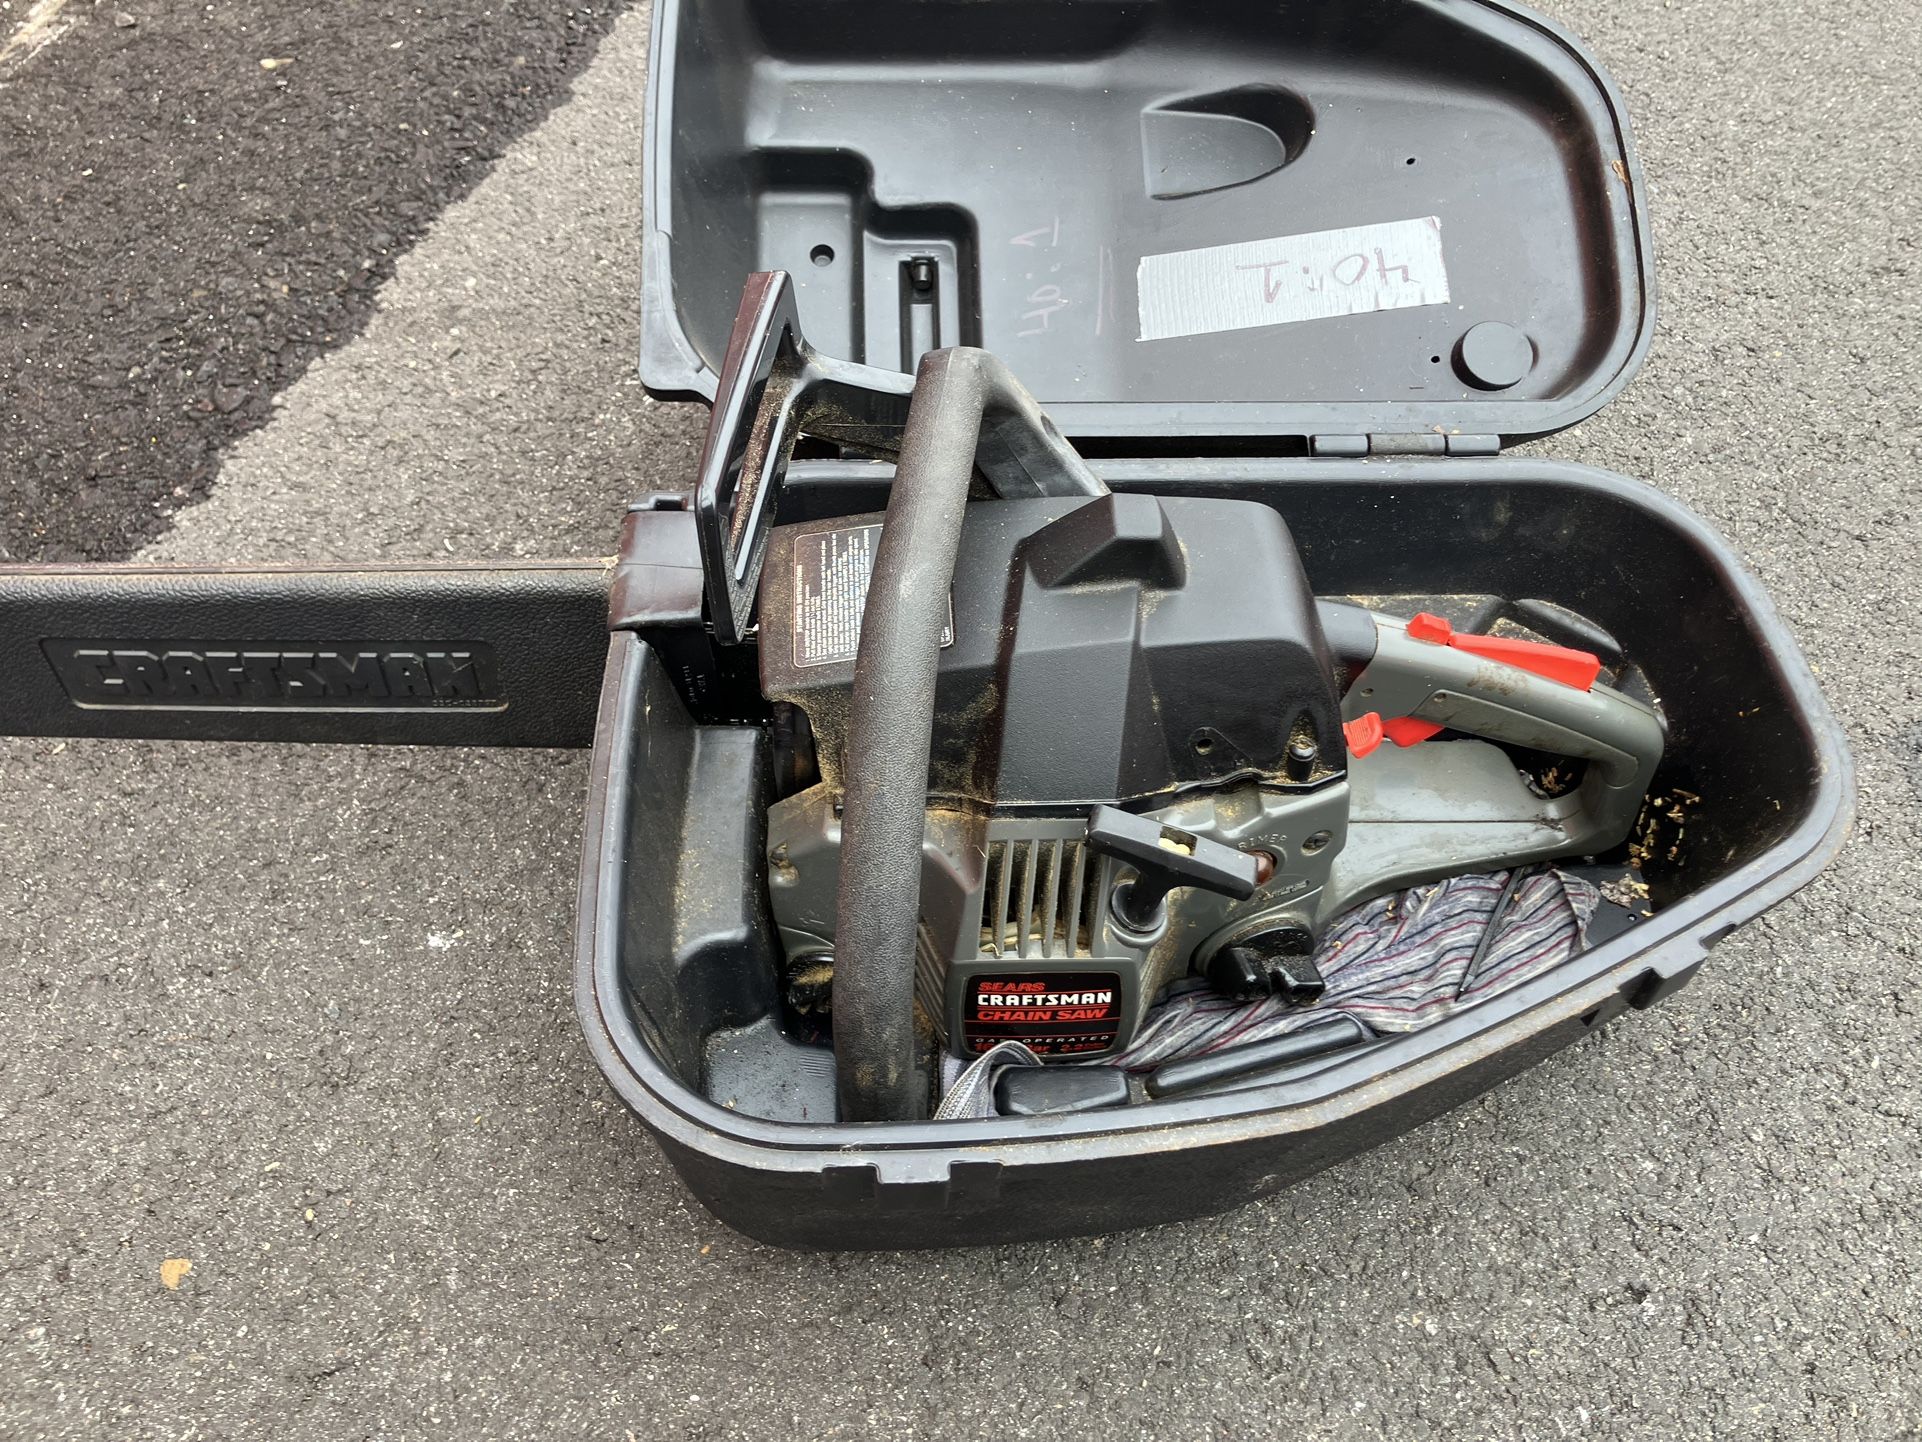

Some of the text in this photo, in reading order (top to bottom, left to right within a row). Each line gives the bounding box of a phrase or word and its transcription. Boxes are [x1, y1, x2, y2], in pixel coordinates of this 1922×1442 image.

[74, 649, 482, 697] CRAFTSMAN
[978, 982, 1045, 992] SEARS
[977, 991, 1112, 1006] CRAFTSMAN
[977, 1008, 1108, 1021] CHAIN SAW
[1022, 1035, 1109, 1043] OPERATED
